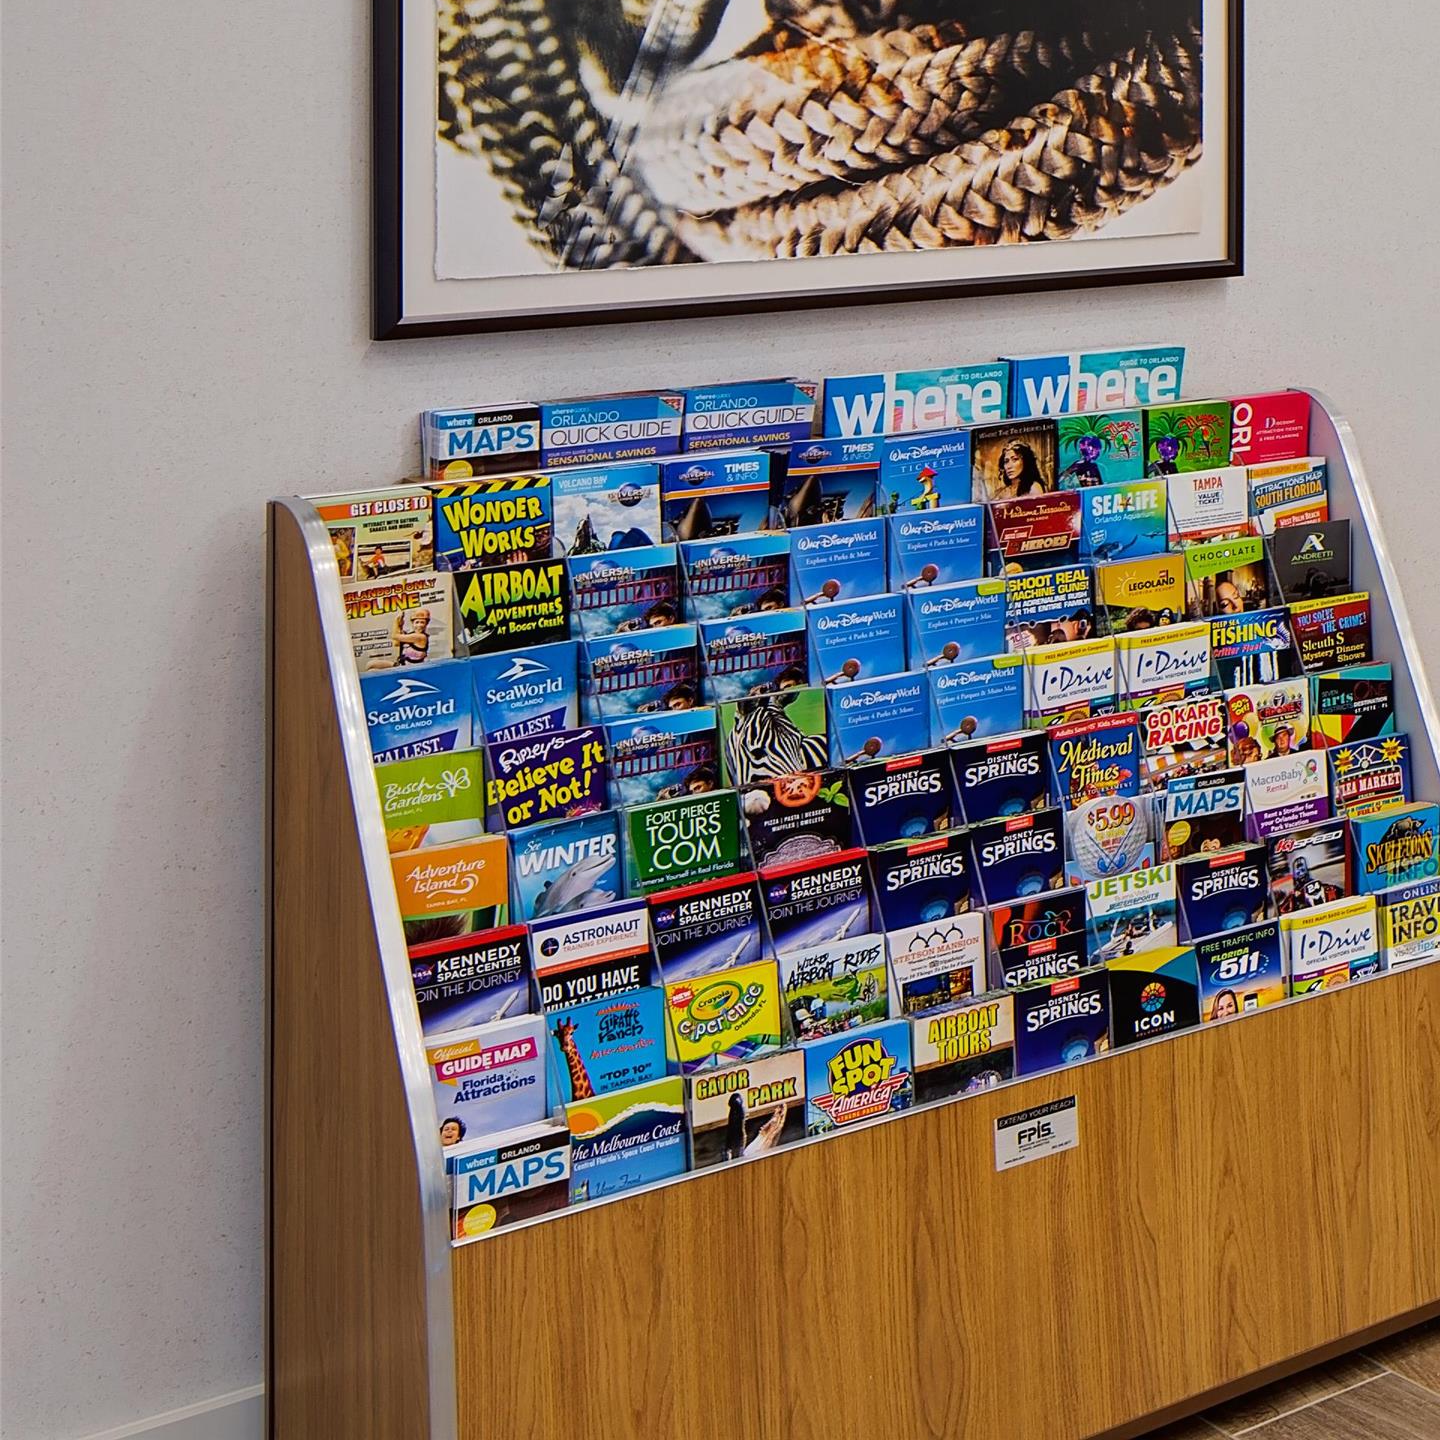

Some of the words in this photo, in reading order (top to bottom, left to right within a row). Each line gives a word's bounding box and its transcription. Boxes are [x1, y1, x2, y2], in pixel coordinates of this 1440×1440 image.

[939, 375, 960, 383] GUIDE
[961, 373, 969, 381] TO
[971, 370, 1003, 380] ORLANDO
[1023, 358, 1177, 416] where
[694, 397, 758, 412] ORLANDO
[832, 373, 1001, 437] where
[446, 416, 473, 427] where
[478, 414, 513, 425] ORLANDO
[551, 410, 620, 427] ORLANDO
[692, 410, 748, 431] QUICK
[751, 406, 805, 426] GUIDE
[448, 424, 535, 456] MAPS
[549, 425, 610, 447] QUICK
[613, 419, 672, 442] GUIDE
[546, 451, 613, 467] SENSATIONAL
[616, 446, 657, 461] SAVINGS
[724, 461, 759, 473] TIMES
[901, 459, 955, 473] TICKETS
[558, 478, 590, 490] VOLCANO
[591, 475, 608, 487] BAY
[1193, 476, 1223, 491] TAMPA
[1255, 474, 1304, 495] ATTRACTIONS
[1305, 471, 1323, 484] MAP
[1255, 490, 1287, 508] SOUTH
[1288, 482, 1322, 501] FLORIDA
[350, 502, 372, 517] GET
[374, 499, 409, 514] CLOSE
[412, 497, 428, 510] TO
[443, 497, 544, 531] WONDER
[1198, 497, 1220, 505] TICKET
[459, 526, 536, 559] WORKS
[1192, 545, 1256, 562] CHOCOLATE
[1291, 551, 1333, 561] ANDRETTI
[461, 563, 564, 618] AIRBOAT
[1008, 574, 1052, 591] SHOOT
[1056, 569, 1089, 584] REAL
[1058, 581, 1089, 594] GUNS!
[1128, 574, 1177, 592] LEGOLAND
[486, 598, 563, 625] ADVENTURES
[497, 625, 506, 635] AT
[509, 621, 536, 633] BOGGY
[538, 614, 564, 629] CREEK
[1322, 622, 1337, 633] THE
[1339, 612, 1367, 629] CRIME!
[1212, 619, 1278, 647] FISHING
[1302, 636, 1334, 652] Sleuth
[594, 648, 655, 665] UNIVERSAL
[1303, 648, 1334, 661] Mystery
[1336, 642, 1364, 654] Dinner
[1338, 652, 1365, 663] Shows
[486, 677, 563, 704] SeaWorld
[510, 697, 544, 709] ORLANDO
[1322, 692, 1354, 708] arts
[367, 699, 455, 727] SeaWorld
[395, 719, 432, 730] ORLANDO
[1148, 713, 1173, 732] GO
[1175, 702, 1219, 727] KART
[1149, 720, 1221, 748] RACING
[1058, 733, 1133, 773] Medieval
[487, 760, 575, 806] Believe
[582, 741, 604, 765] It
[886, 770, 919, 783] DISNEY
[1072, 764, 1119, 790] Times
[1251, 768, 1304, 788] MacroBaby
[384, 777, 435, 799] Busch
[507, 803, 535, 824] or
[539, 772, 592, 813] Not!
[864, 773, 942, 807] SPRINGS
[1267, 783, 1289, 793] Rental
[384, 790, 444, 813] Gardens
[680, 801, 720, 818] PIERCE
[1173, 785, 1241, 820] MAPS
[648, 813, 721, 847] TOURS
[1087, 802, 1135, 832] $5.99
[1293, 830, 1343, 850] SPEED
[1366, 831, 1433, 874] SKELETONS
[518, 833, 617, 876] WINTER
[648, 836, 721, 873] .COM
[405, 858, 486, 882] Adventure
[1089, 864, 1171, 901] JETSKI
[413, 877, 457, 894] Island
[563, 918, 640, 947] ASTRONAUT
[1201, 941, 1220, 954] FREE
[1222, 933, 1254, 949] TRAFFIC
[1256, 928, 1275, 940] INFO
[1392, 917, 1438, 944] INFO
[437, 942, 521, 972] KENNEDY
[1211, 947, 1249, 963] FLORIDA
[1219, 951, 1260, 980] 511
[437, 966, 472, 983] SPACE
[474, 955, 521, 976] CENTER
[441, 980, 464, 997] THE
[466, 968, 521, 993] JOURNEY
[543, 984, 566, 1004] DO
[568, 976, 597, 997] YOU
[600, 965, 640, 990] HAVE
[696, 989, 730, 1009] Crayola
[928, 1003, 999, 1044] AIRBOAT
[1134, 1010, 1175, 1034] ICON
[432, 1043, 473, 1060] Official
[441, 1053, 492, 1077] GUIDE
[493, 1042, 532, 1065] MAP
[827, 1039, 883, 1075] FUN
[937, 1030, 992, 1064] TOURS
[454, 1074, 536, 1105] Attractions
[462, 1073, 504, 1090] Florida
[696, 1069, 749, 1100] GATOR
[832, 1058, 895, 1099] SPOT
[748, 1077, 796, 1108] PARK
[828, 1086, 891, 1114] AMERICA
[999, 1113, 1027, 1127] EXTEND
[1029, 1107, 1048, 1117] YOUR
[1050, 1099, 1074, 1111] REACH
[501, 1143, 541, 1160] ORLANDO
[571, 1144, 589, 1161] the
[591, 1129, 651, 1158] Melbourne
[652, 1120, 681, 1140] Coast
[467, 1150, 565, 1202] MAPS
